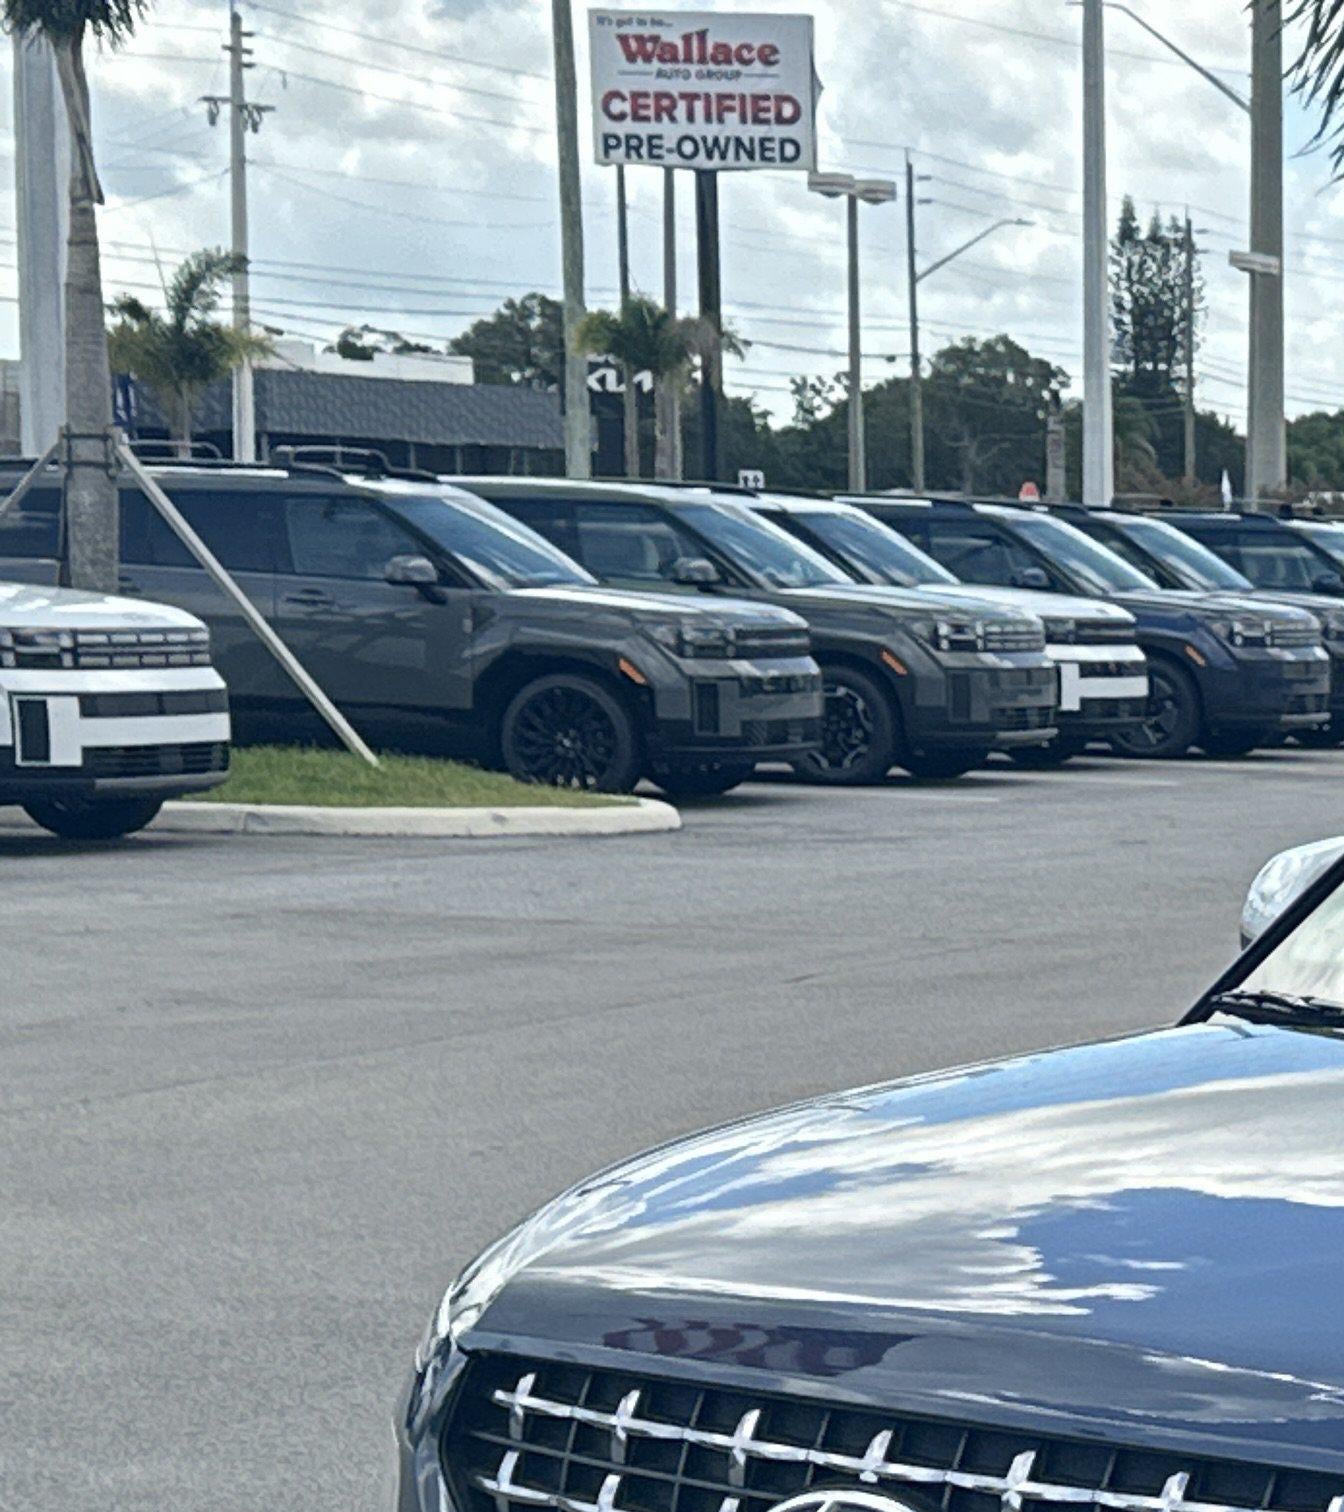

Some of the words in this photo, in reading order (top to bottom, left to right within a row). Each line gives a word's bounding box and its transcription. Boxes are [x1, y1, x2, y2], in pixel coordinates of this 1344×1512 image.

[615, 28, 780, 66] Wallace
[655, 68, 692, 80] AUTO
[695, 69, 742, 81] GROUP
[601, 89, 802, 126] CERTIFIED
[602, 132, 801, 163] PRE-OWNED
